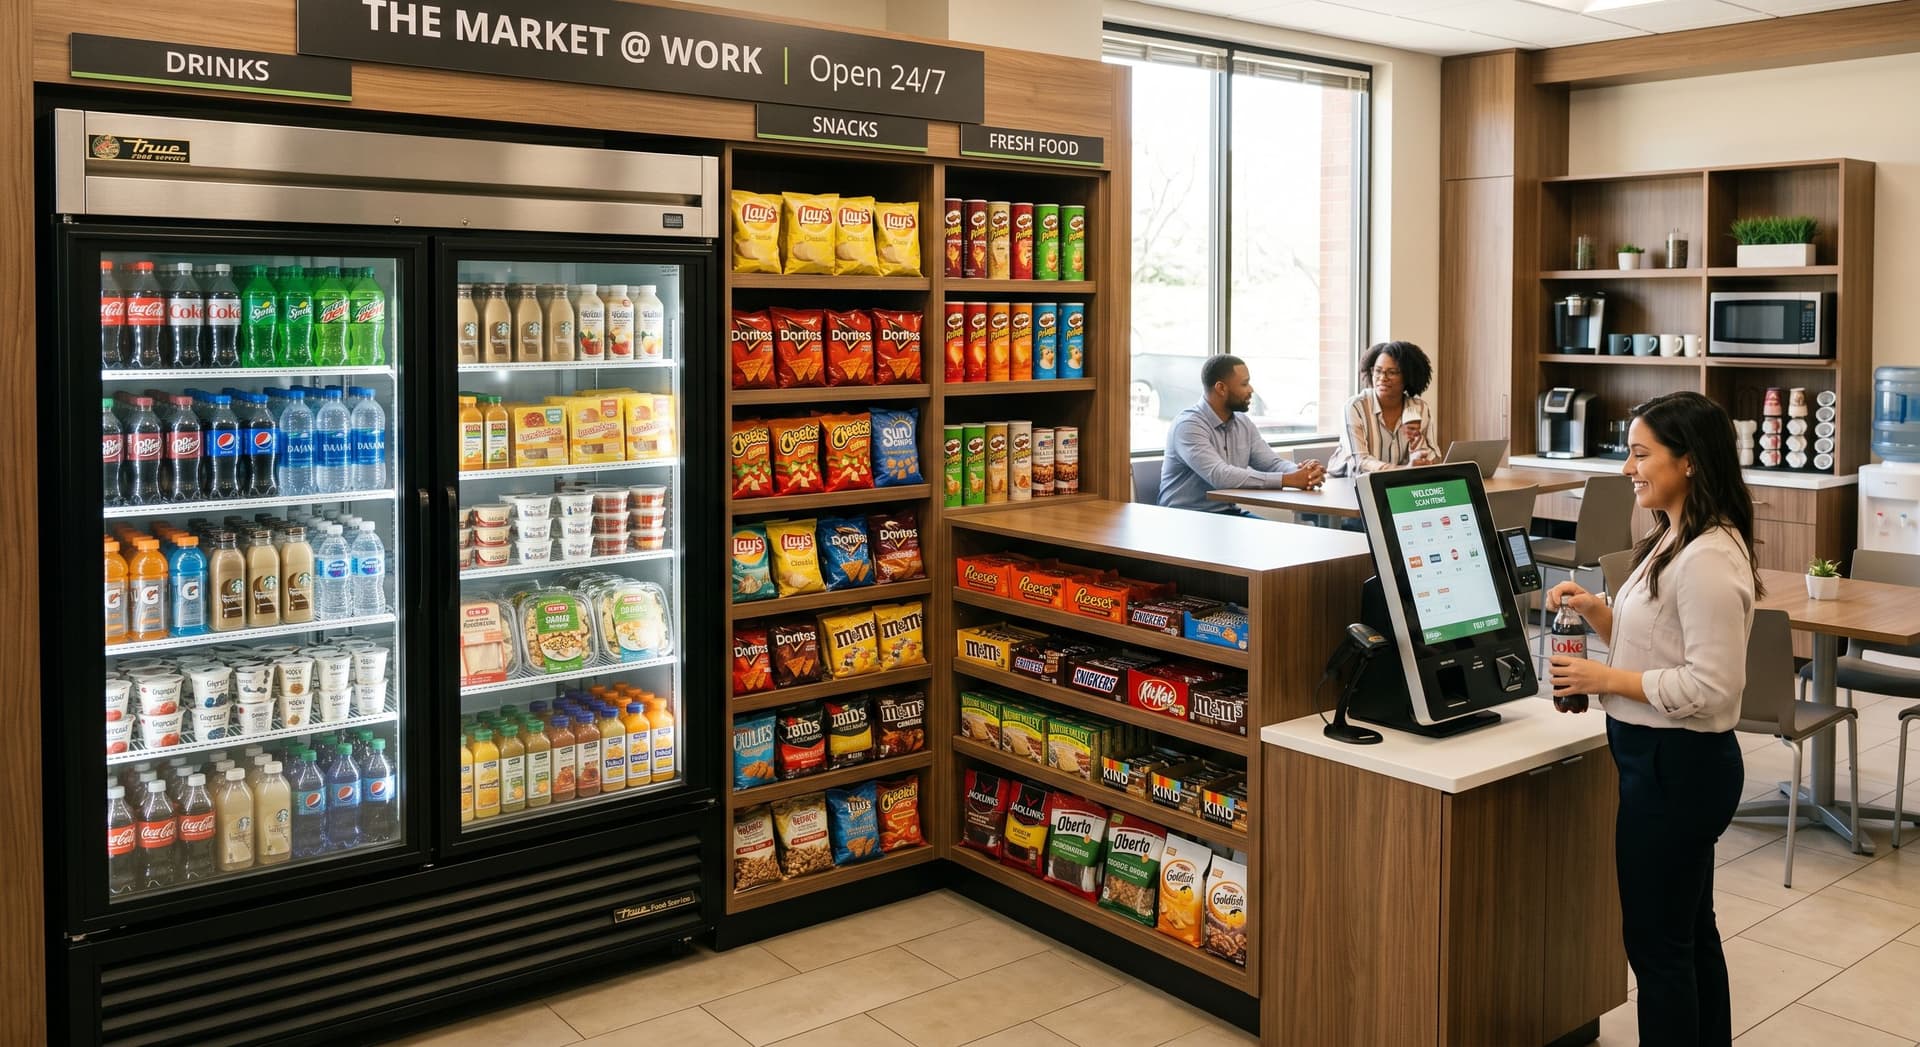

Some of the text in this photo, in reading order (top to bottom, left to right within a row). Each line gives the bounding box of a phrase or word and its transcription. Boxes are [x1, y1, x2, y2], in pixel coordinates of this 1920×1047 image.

[362, 0, 763, 75] THE MARKET @ WORK
[166, 51, 270, 81] DRINKS
[809, 54, 947, 95] Open 24/7
[812, 116, 879, 138] SNACKS
[989, 133, 1079, 156] FRESH FOOD
[744, 203, 775, 222] Lay's
[800, 205, 831, 224] Lay's
[841, 207, 870, 225] Lay's
[886, 213, 914, 229] Lay's
[732, 329, 773, 342] Doritos
[781, 329, 822, 342] Doritos
[832, 329, 872, 341] Doritos
[882, 329, 921, 341] Doritos
[831, 420, 871, 449] Cheetos
[733, 537, 763, 555] Lay's
[783, 534, 812, 550] Lay's
[1132, 609, 1168, 628] SNICKERS
[1551, 638, 1583, 653] Coke
[1073, 668, 1117, 692] SNICKERS
[1102, 767, 1129, 785] KIND
[1152, 784, 1181, 803] KIND
[1203, 800, 1234, 820] KIND
[1057, 815, 1092, 834] Oberto
[1113, 833, 1151, 853] Oberto
